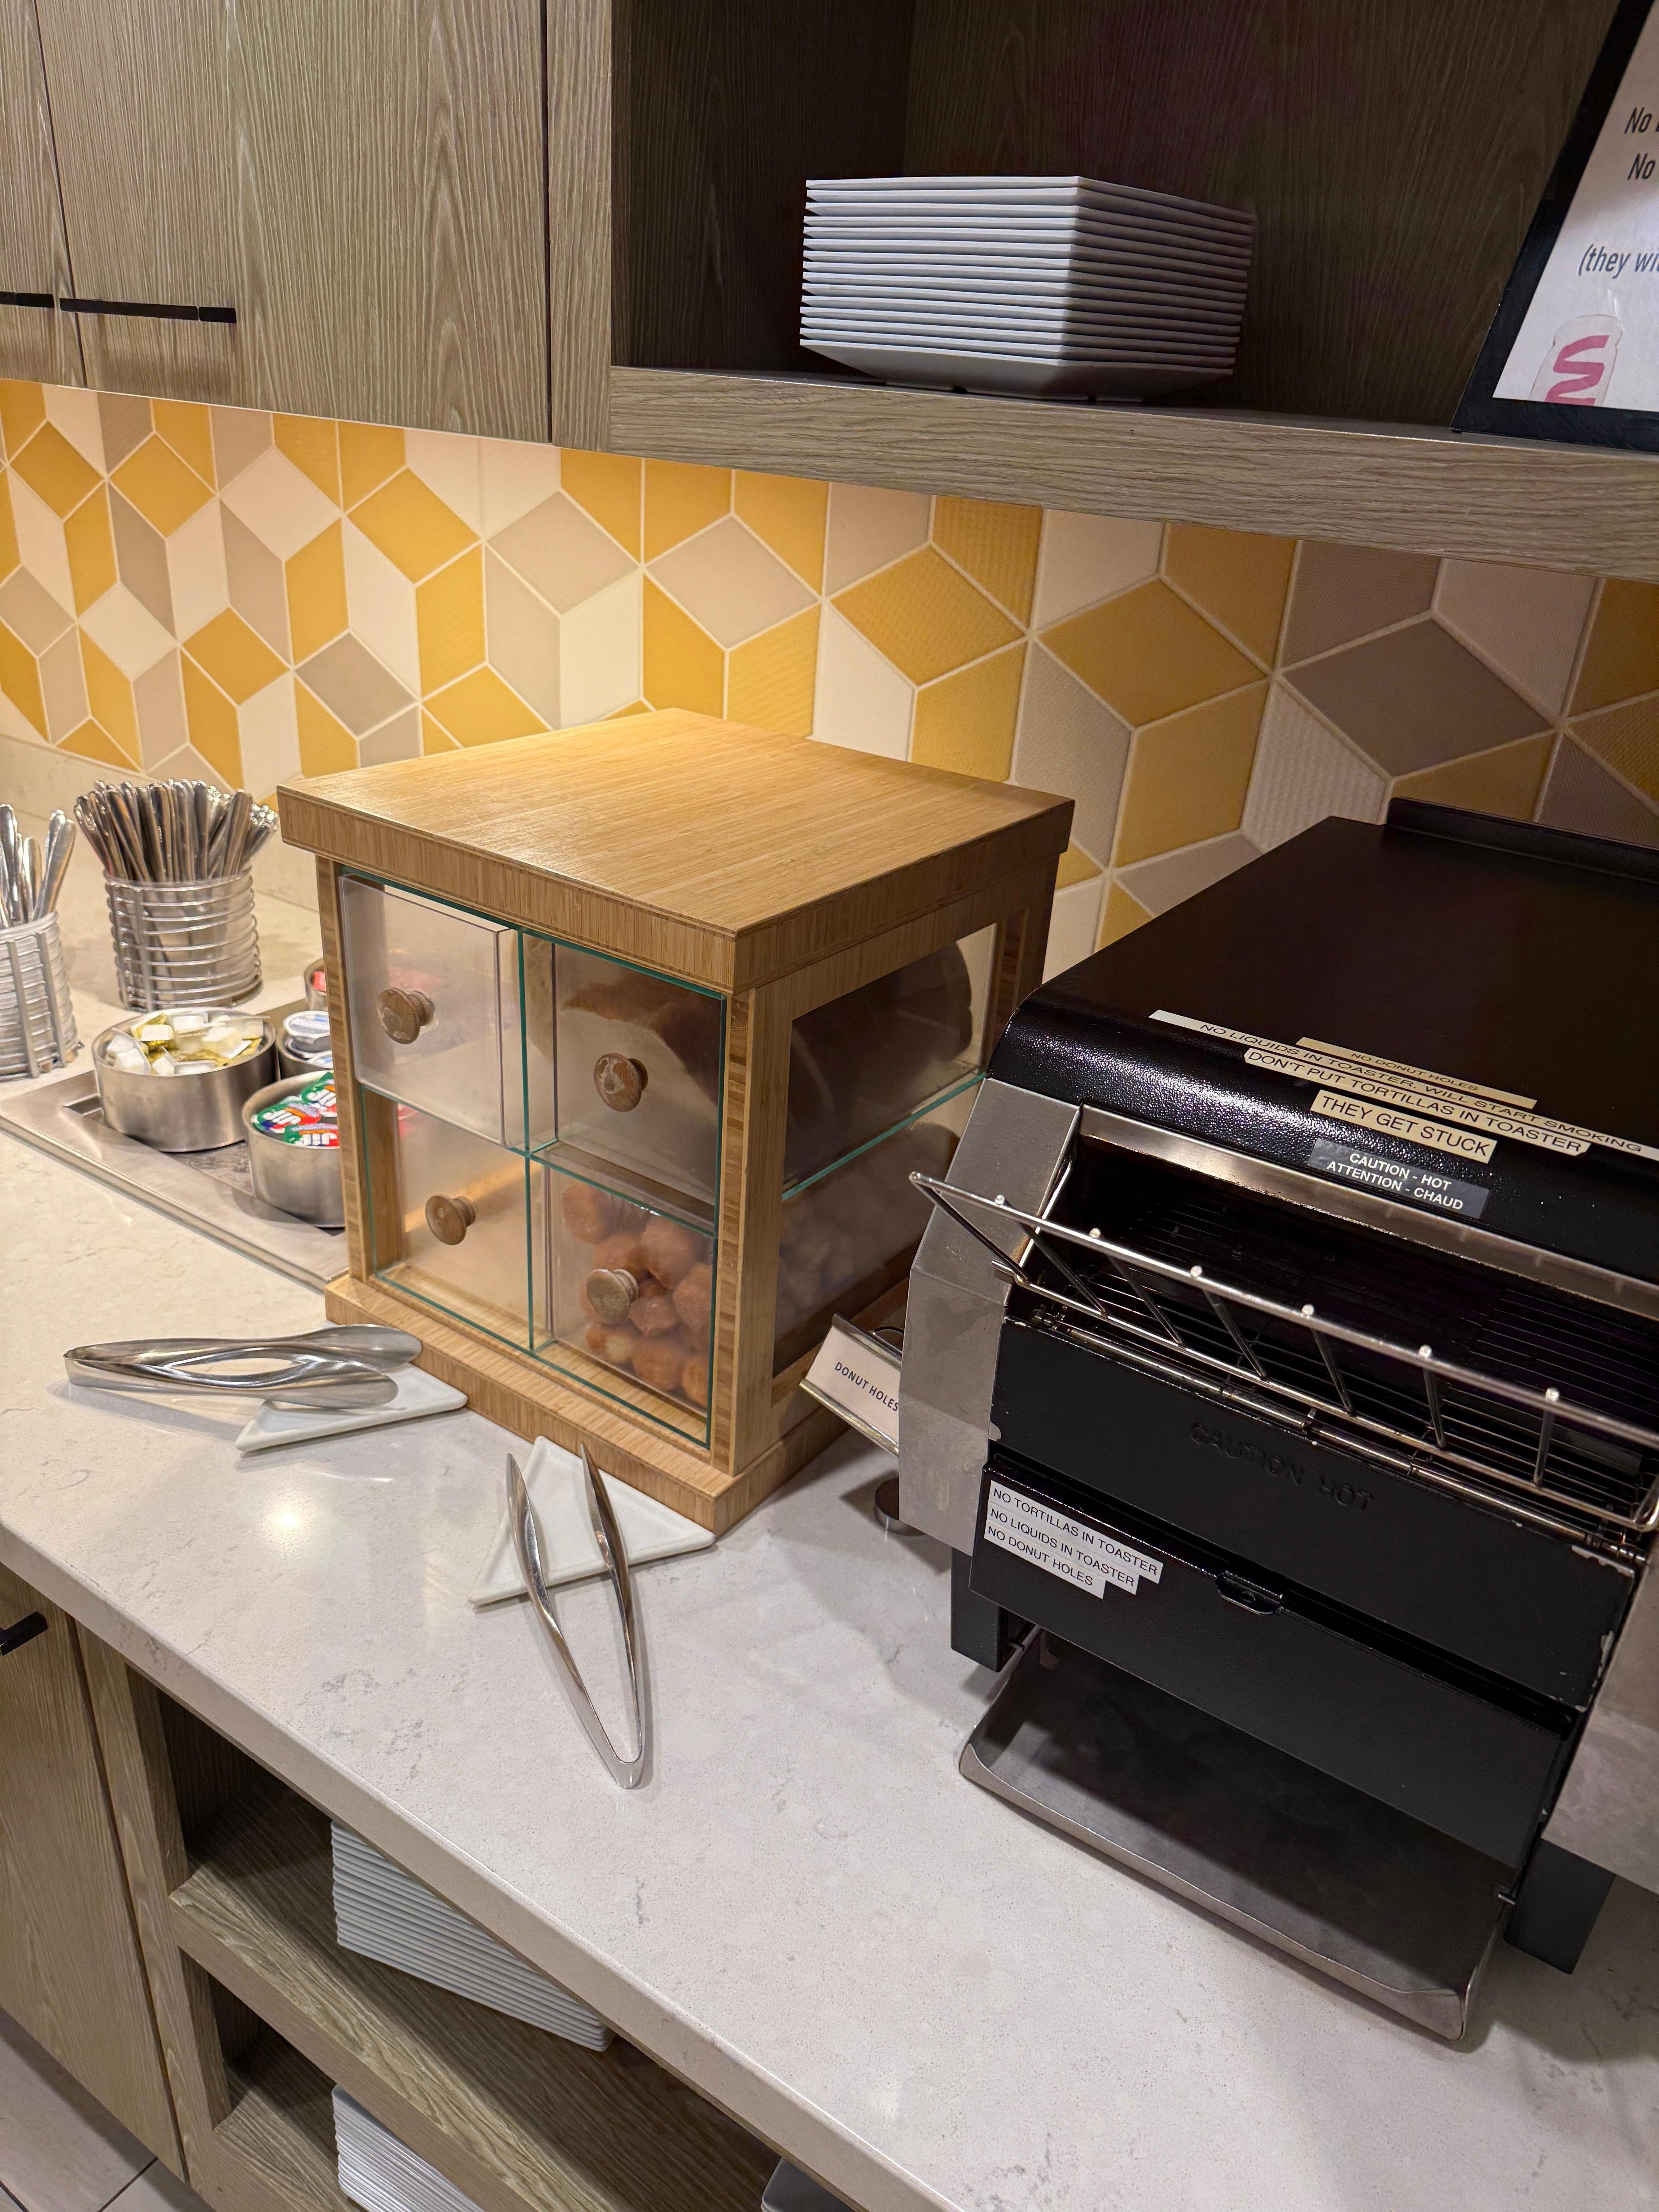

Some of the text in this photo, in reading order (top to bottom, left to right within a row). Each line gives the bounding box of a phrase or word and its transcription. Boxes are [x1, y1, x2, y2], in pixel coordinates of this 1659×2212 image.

[1624, 106, 1652, 134] No
[1627, 153, 1656, 180] No
[1578, 244, 1631, 279] (they
[1200, 1024, 1642, 1152] NO LIQUIDS IN TOASTER. WILL START SMOKING
[1351, 1053, 1478, 1091] NO DONUT HOLES
[1248, 1051, 1582, 1152] DON'T PUT TORTILLAS IN TOASTER
[1321, 1096, 1491, 1156] THEY GET STUCK
[1326, 1161, 1402, 1192] ATTENTION
[1413, 1187, 1463, 1210] CHAUD
[1349, 1153, 1410, 1179] CAUTION
[1421, 1174, 1452, 1191] HOT
[835, 1361, 899, 1412] DONUT HOLES
[1190, 1422, 1374, 1511] CAUTION HOT
[988, 1526, 1093, 1586] NO DONUT HOLES
[991, 1508, 1135, 1587] NO LIQUIDS IN TOASTER
[993, 1488, 1158, 1575] NO TORTILLAS IN TOASTER
